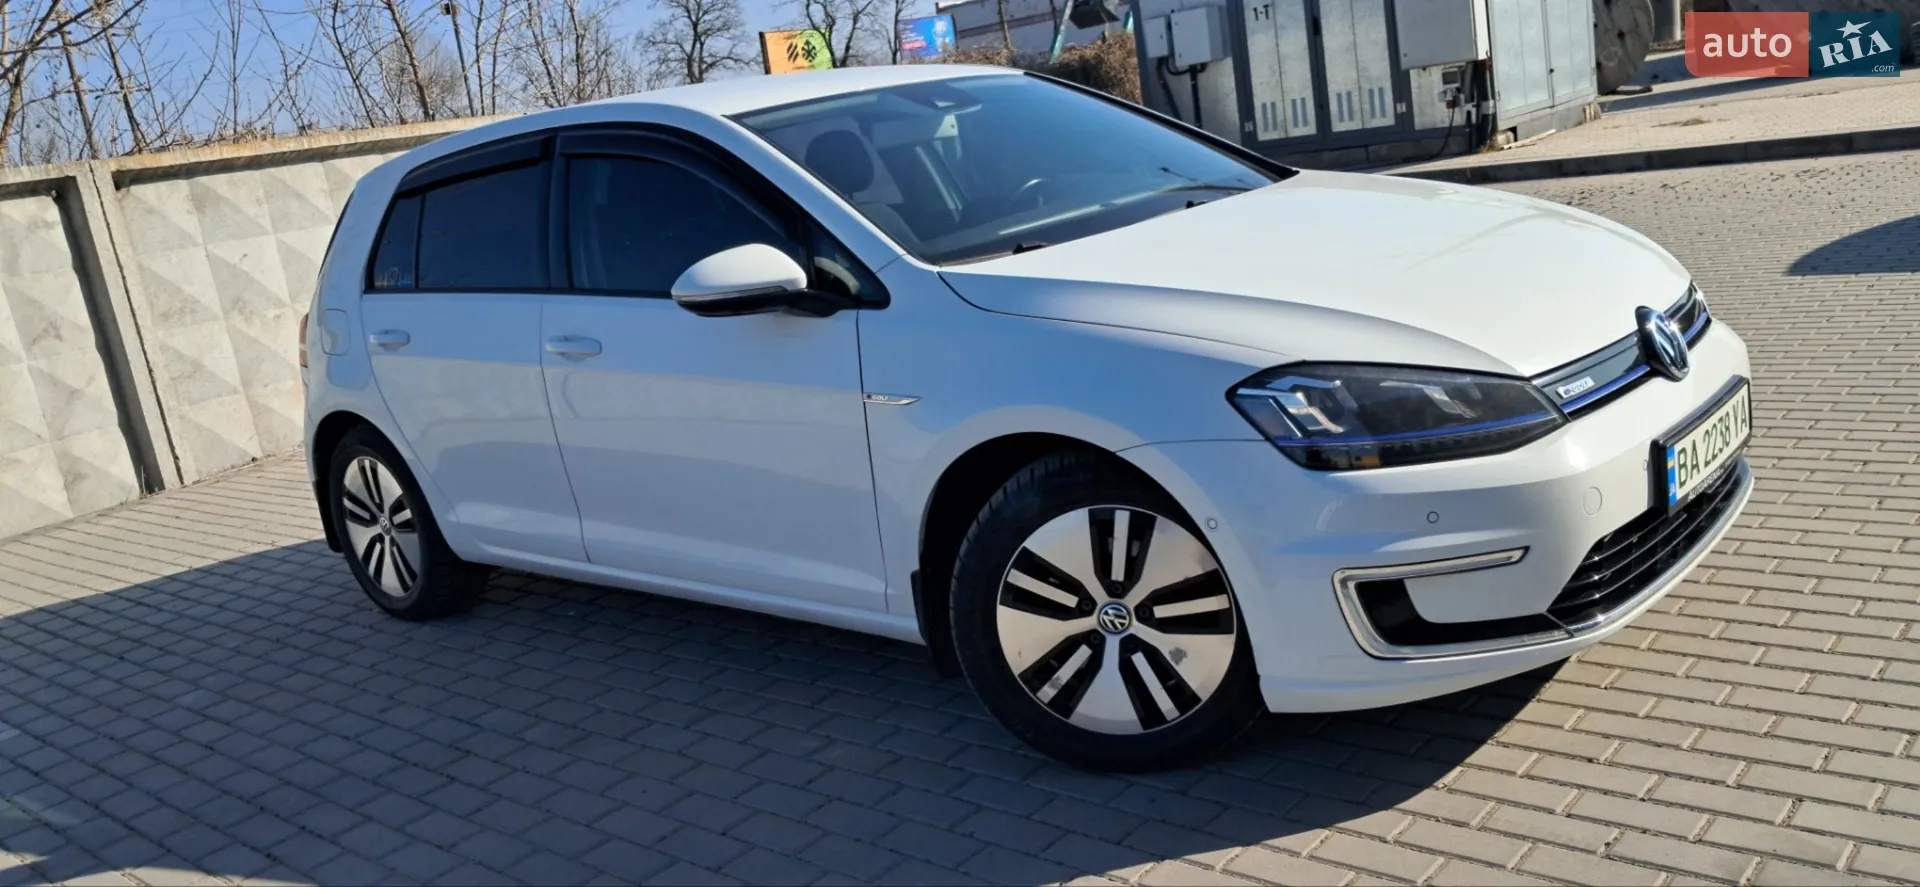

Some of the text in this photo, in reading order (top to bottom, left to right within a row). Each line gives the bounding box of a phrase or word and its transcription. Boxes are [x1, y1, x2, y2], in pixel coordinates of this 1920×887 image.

[1677, 395, 1748, 490] BA 2238 YA
